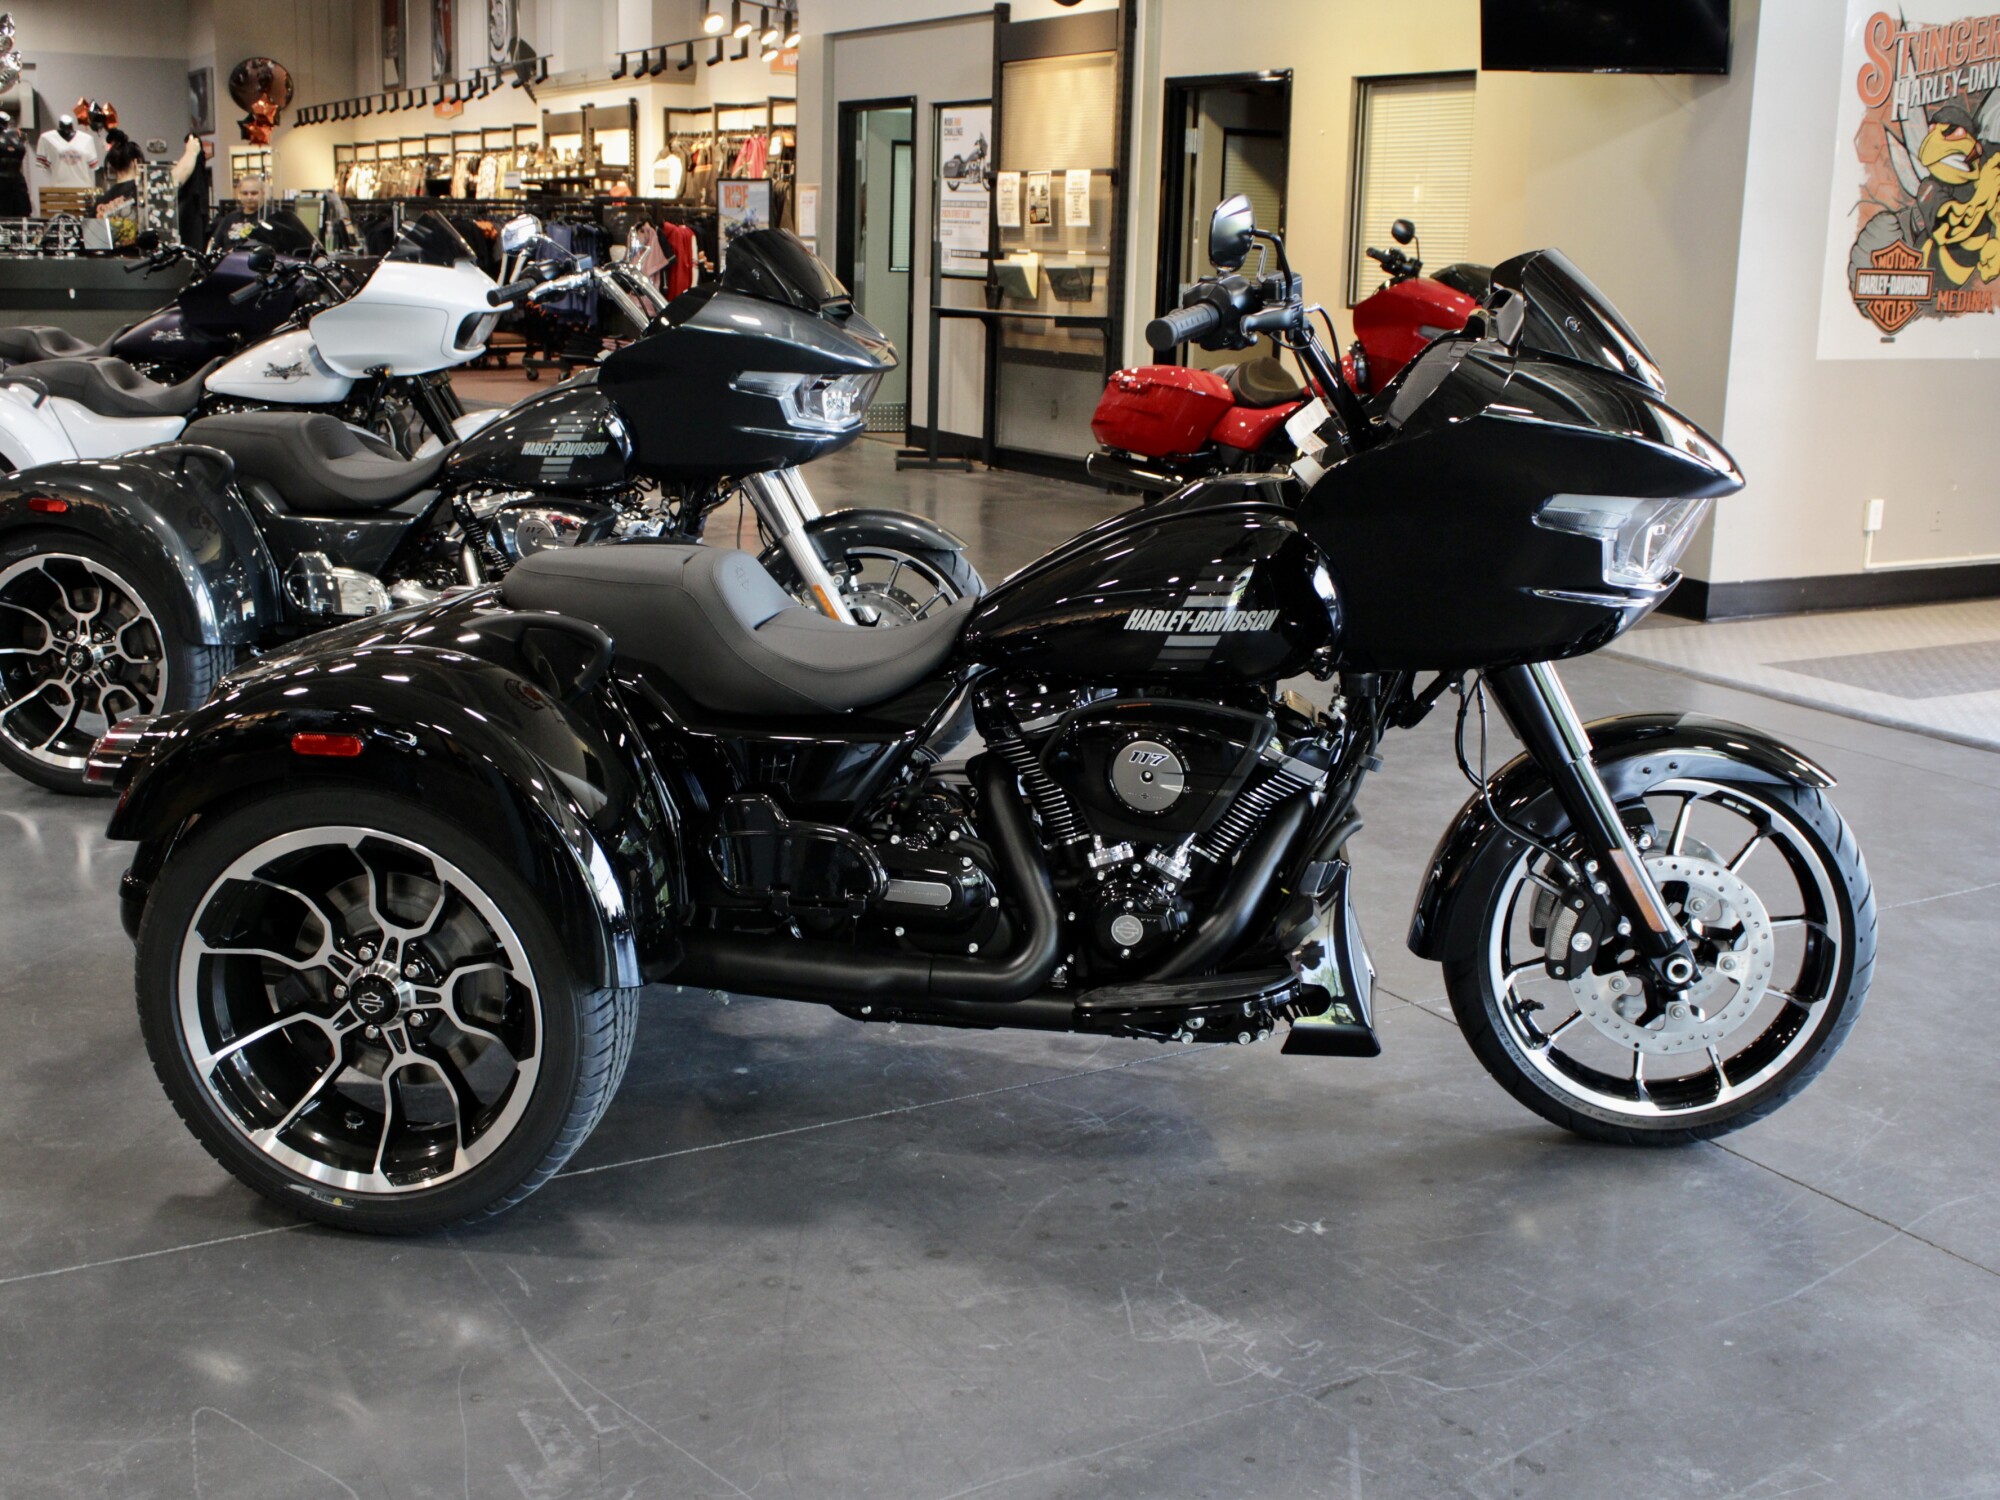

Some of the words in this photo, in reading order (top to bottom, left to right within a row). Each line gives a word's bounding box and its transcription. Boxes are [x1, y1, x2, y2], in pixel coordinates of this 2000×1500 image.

[1891, 60, 2000, 122] HARLEY-DAV
[724, 184, 749, 208] RIDE
[1879, 246, 1917, 269] MOTOR
[1858, 274, 1930, 296] HARLEY-DAVIDSON
[1873, 300, 1911, 326] CYCLES
[1936, 290, 1994, 313] MEDINA
[521, 442, 609, 456] HARLEY-DAVIDSON
[1123, 608, 1280, 633] HARLEY-DAVIDSON
[1129, 750, 1170, 767] 117
